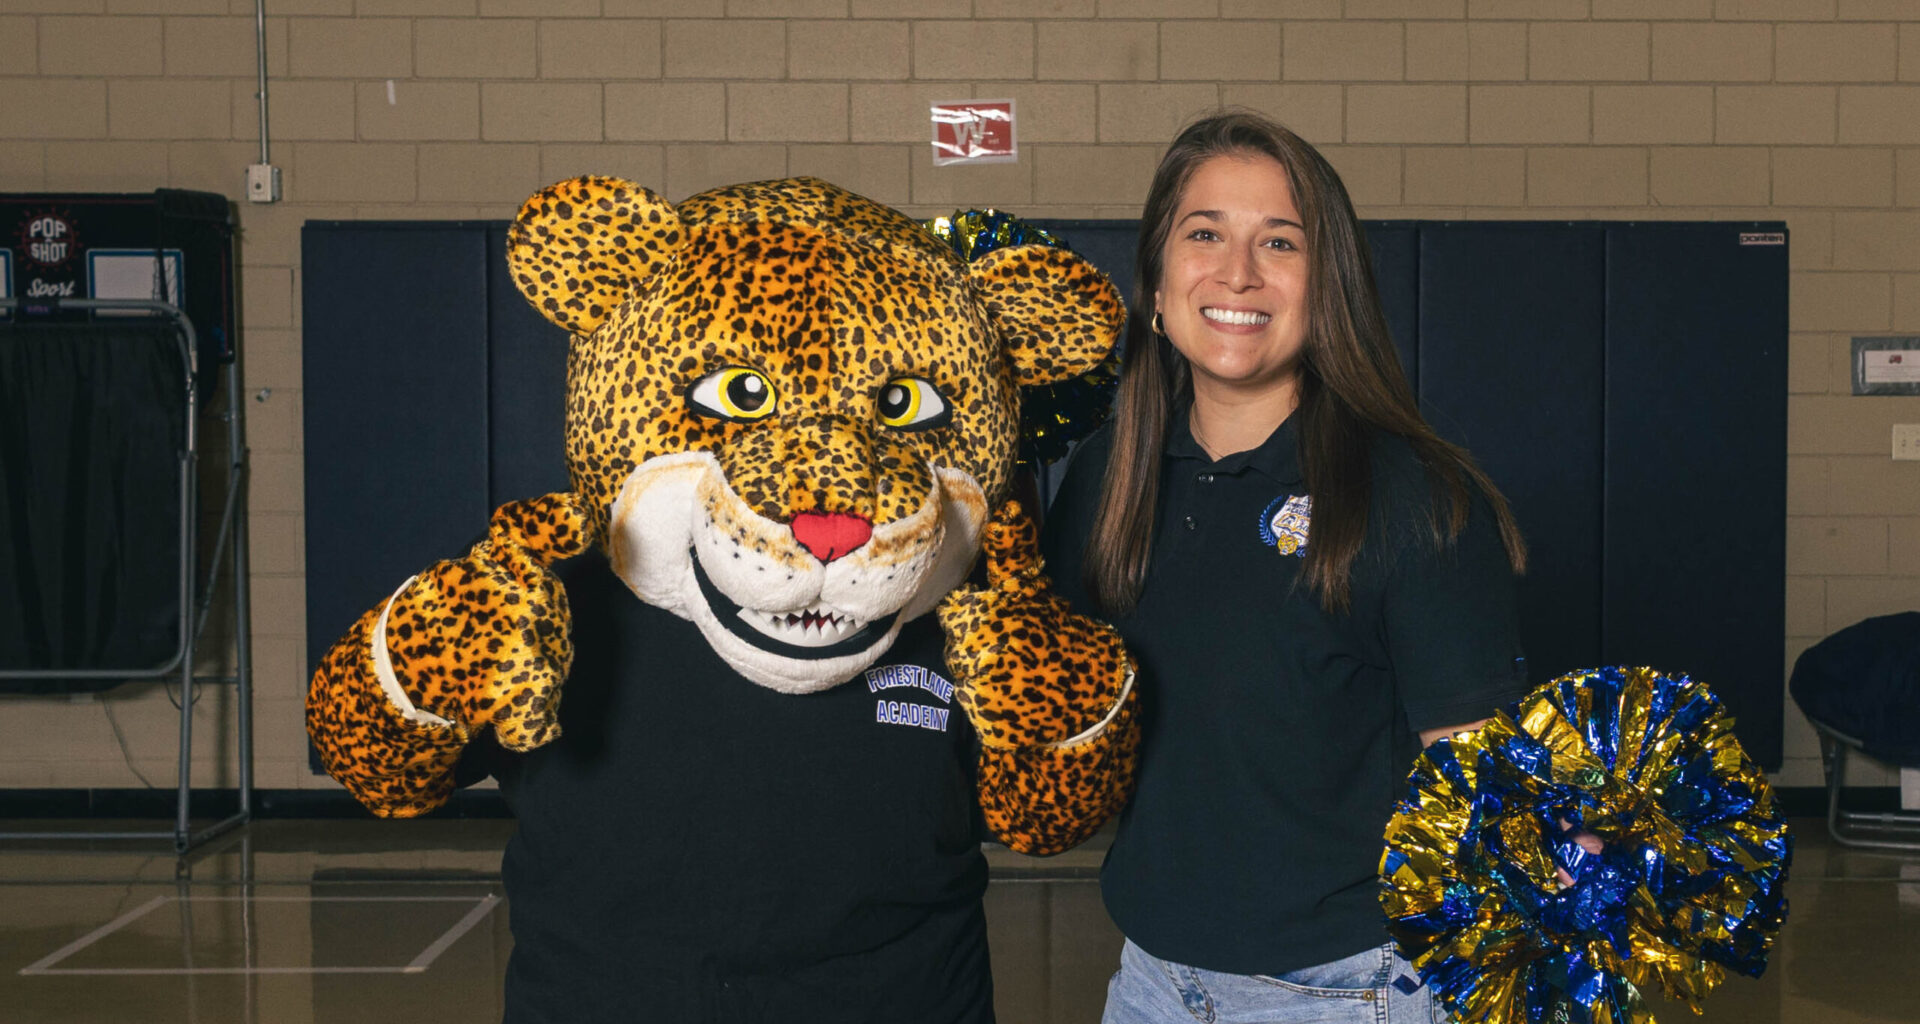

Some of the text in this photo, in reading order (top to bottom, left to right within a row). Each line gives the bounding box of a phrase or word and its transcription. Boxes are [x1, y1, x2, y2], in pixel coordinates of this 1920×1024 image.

[30, 217, 67, 238] POP
[30, 242, 67, 262] SHOT
[27, 278, 75, 298] Sport
[864, 664, 954, 704] FOREST LANE
[876, 700, 950, 732] ACADEMY
